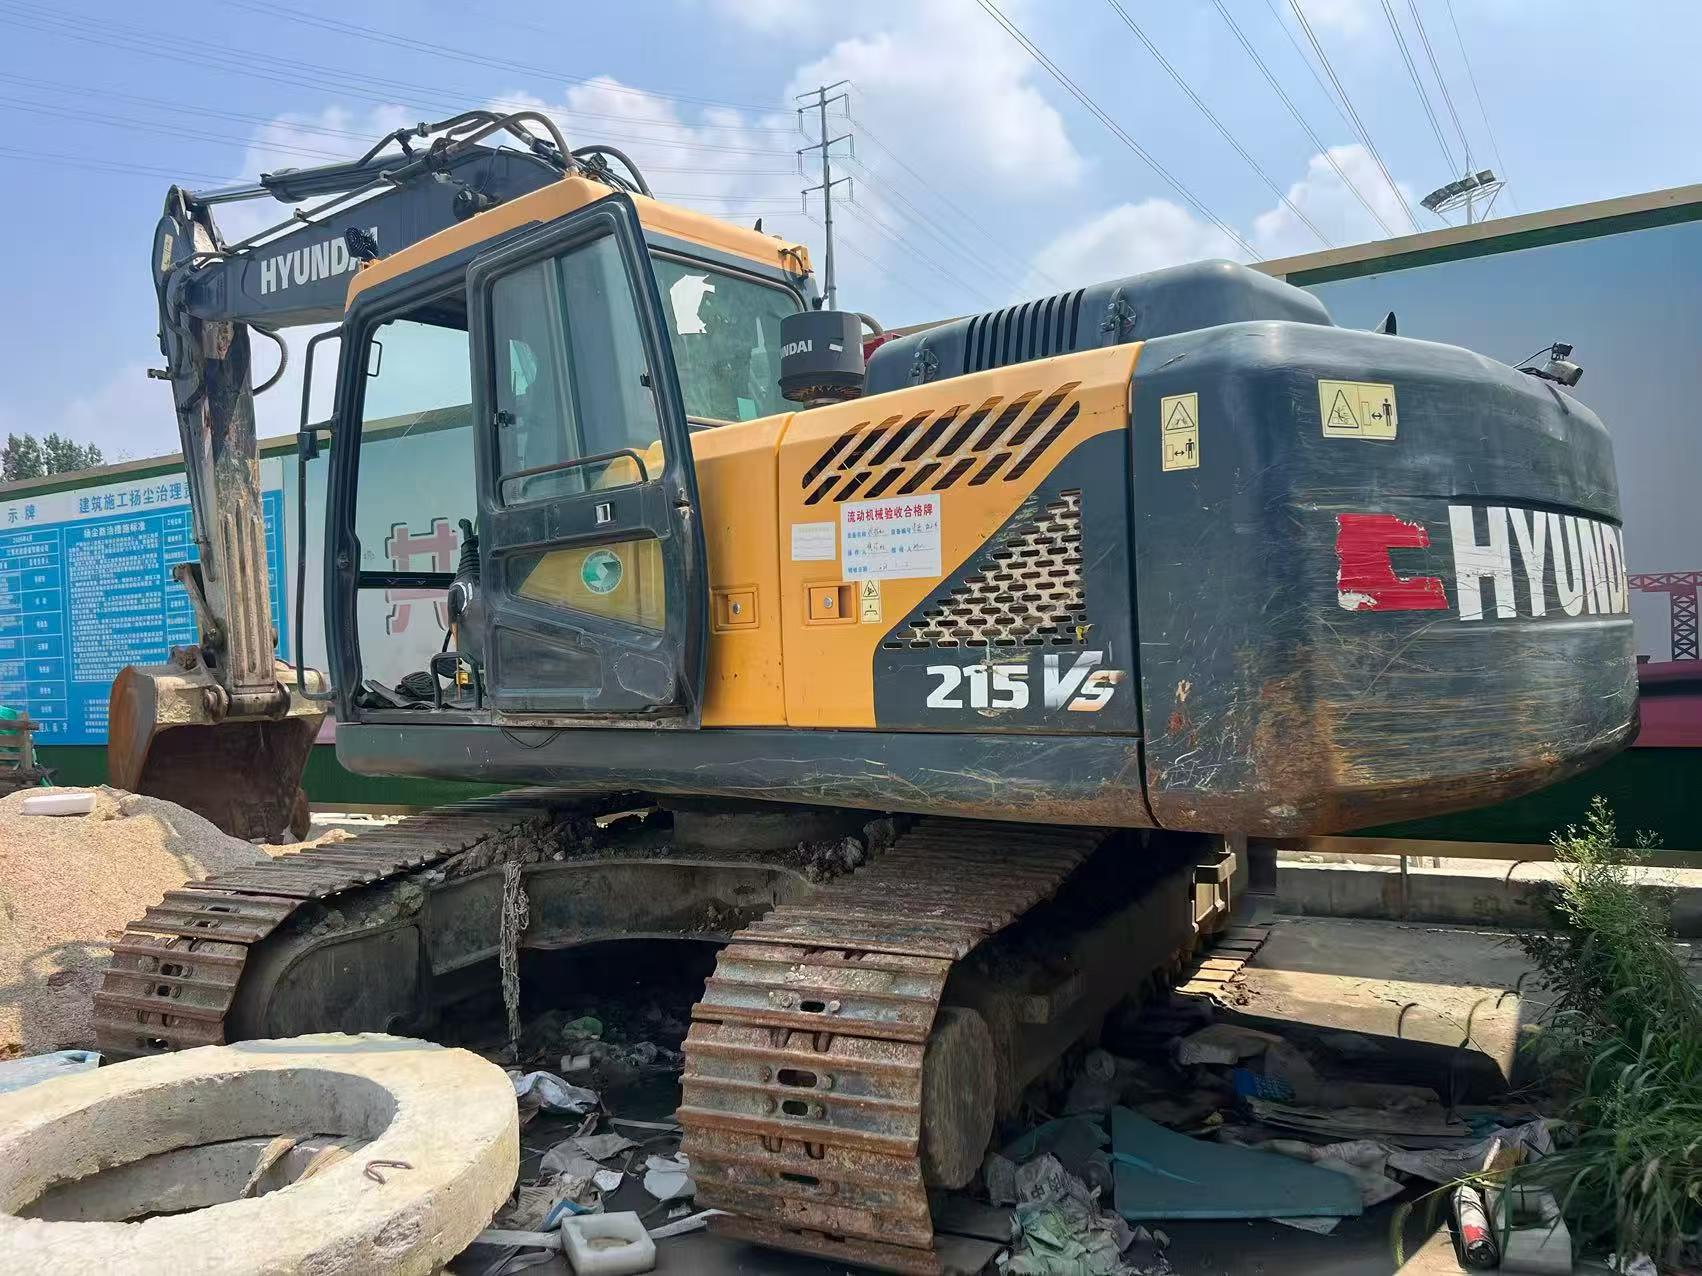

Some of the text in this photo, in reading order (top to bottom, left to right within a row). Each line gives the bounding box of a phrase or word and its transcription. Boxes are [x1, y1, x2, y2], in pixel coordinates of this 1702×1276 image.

[261, 226, 378, 295] HYUND
[847, 503, 933, 523] 流动机械验收合格牌
[1447, 505, 1629, 621] HYUND
[926, 664, 1030, 709] 215
